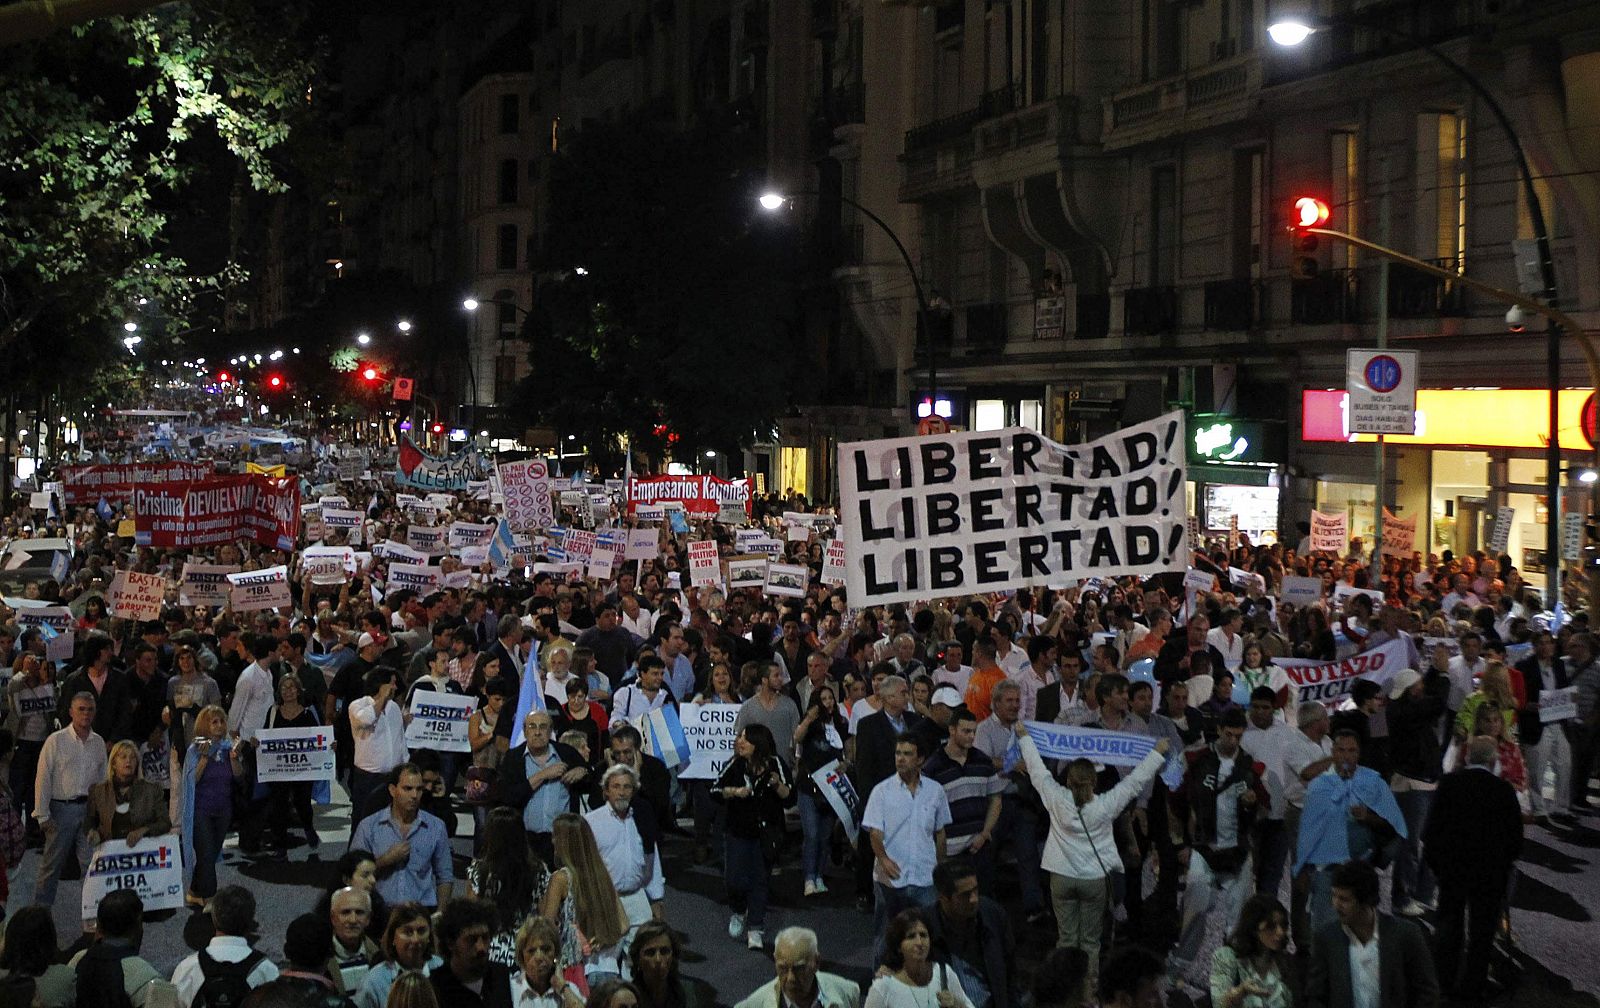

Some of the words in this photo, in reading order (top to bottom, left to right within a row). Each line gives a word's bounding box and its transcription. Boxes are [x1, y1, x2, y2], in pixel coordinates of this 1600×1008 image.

[855, 421, 1177, 492] LIBERTAD!
[410, 466, 476, 488] LLEGAMOS
[631, 478, 698, 504] Empresarios
[703, 475, 749, 506] Kagones
[859, 468, 1182, 542] LIBERTAD!
[563, 539, 594, 555] LIBERTAD
[688, 550, 717, 559] POLITICO
[826, 549, 845, 557] POLIT
[701, 559, 713, 567] CFK
[863, 524, 1184, 596] LIBERTAD!
[239, 572, 283, 586] BASTA!
[393, 571, 437, 585] BASTA!
[421, 704, 472, 721] BASTA!
[425, 721, 452, 732] #18A
[683, 727, 705, 735] CON
[708, 727, 722, 736] LA
[267, 734, 323, 752] BASTA!
[696, 739, 715, 750] NO
[276, 754, 308, 763] #18A
[95, 846, 167, 873] BASTA!
[105, 873, 147, 890] #18A
